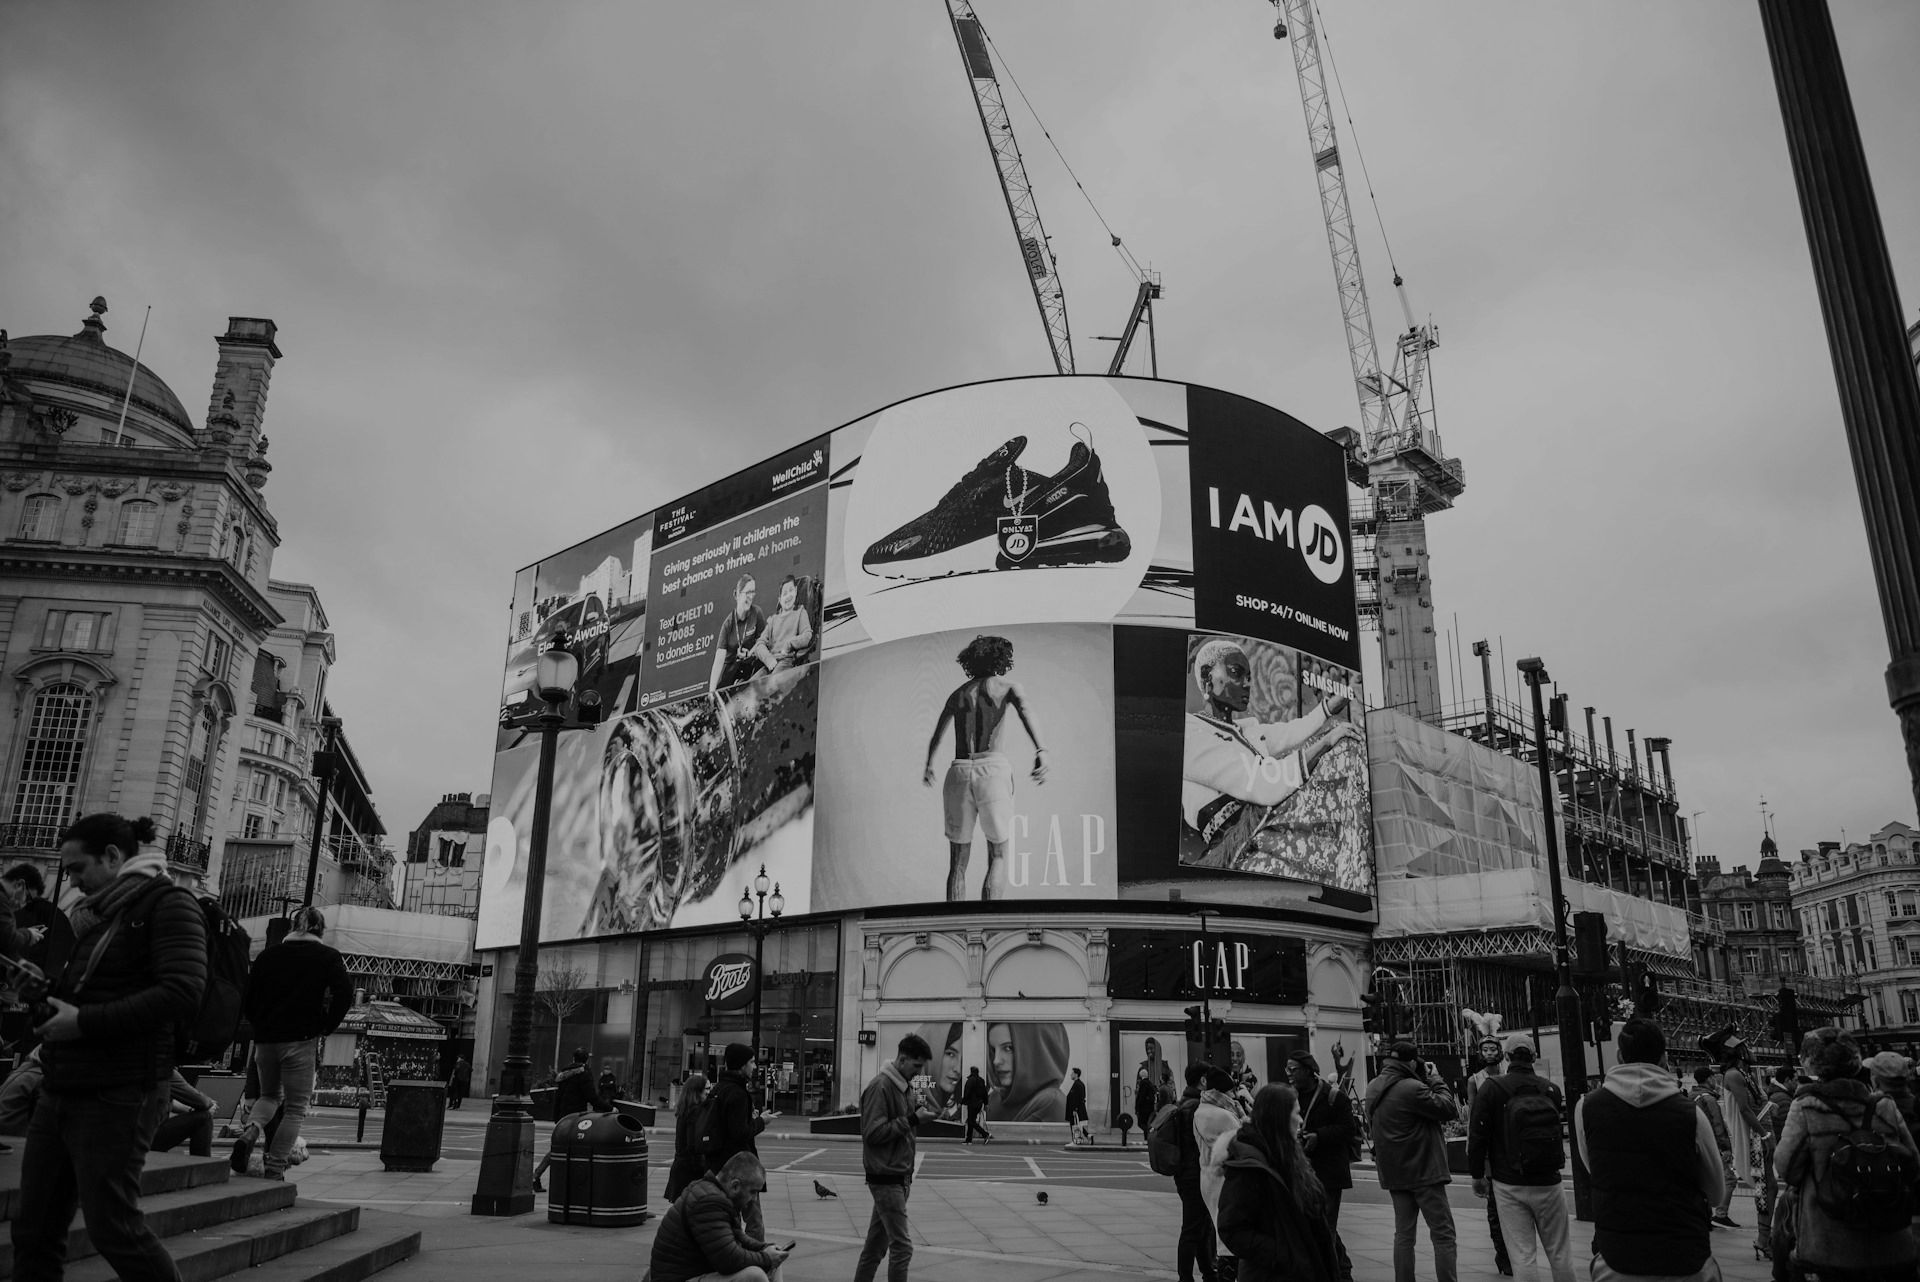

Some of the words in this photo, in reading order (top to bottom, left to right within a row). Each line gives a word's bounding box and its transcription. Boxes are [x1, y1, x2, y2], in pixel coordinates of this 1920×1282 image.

[1025, 240, 1043, 278] WOLFF
[772, 459, 812, 485] WellChild
[671, 506, 686, 518] THE
[1209, 487, 1220, 528] I
[1228, 493, 1294, 549] AM
[664, 559, 690, 577] Giving
[692, 541, 731, 566] seriously
[733, 536, 741, 550] ill
[743, 523, 780, 546] children
[783, 515, 800, 533] the
[1009, 538, 1026, 549] JD
[662, 580, 680, 595] best
[682, 567, 713, 587] chance
[715, 563, 724, 574] to
[726, 551, 756, 571] thrive.
[758, 545, 770, 559] At
[771, 535, 801, 554] home.
[659, 615, 675, 630] Text
[676, 605, 702, 624] CHELT
[703, 601, 713, 615] 10
[1236, 594, 1268, 612] SHOP
[1270, 602, 1293, 619] 24/7
[1295, 611, 1327, 633] ONLINE
[1328, 623, 1349, 641] NOW
[573, 621, 609, 644] Awaits
[658, 635, 666, 647] to
[667, 624, 695, 644] 70085
[656, 652, 664, 663] to
[666, 642, 694, 660] donate
[1302, 671, 1354, 700] SAMSUNG
[1240, 752, 1302, 792] you
[1008, 814, 1105, 887] GAP
[705, 962, 752, 1001] Boots
[772, 970, 811, 986] beauty
[1193, 940, 1249, 990] GAP
